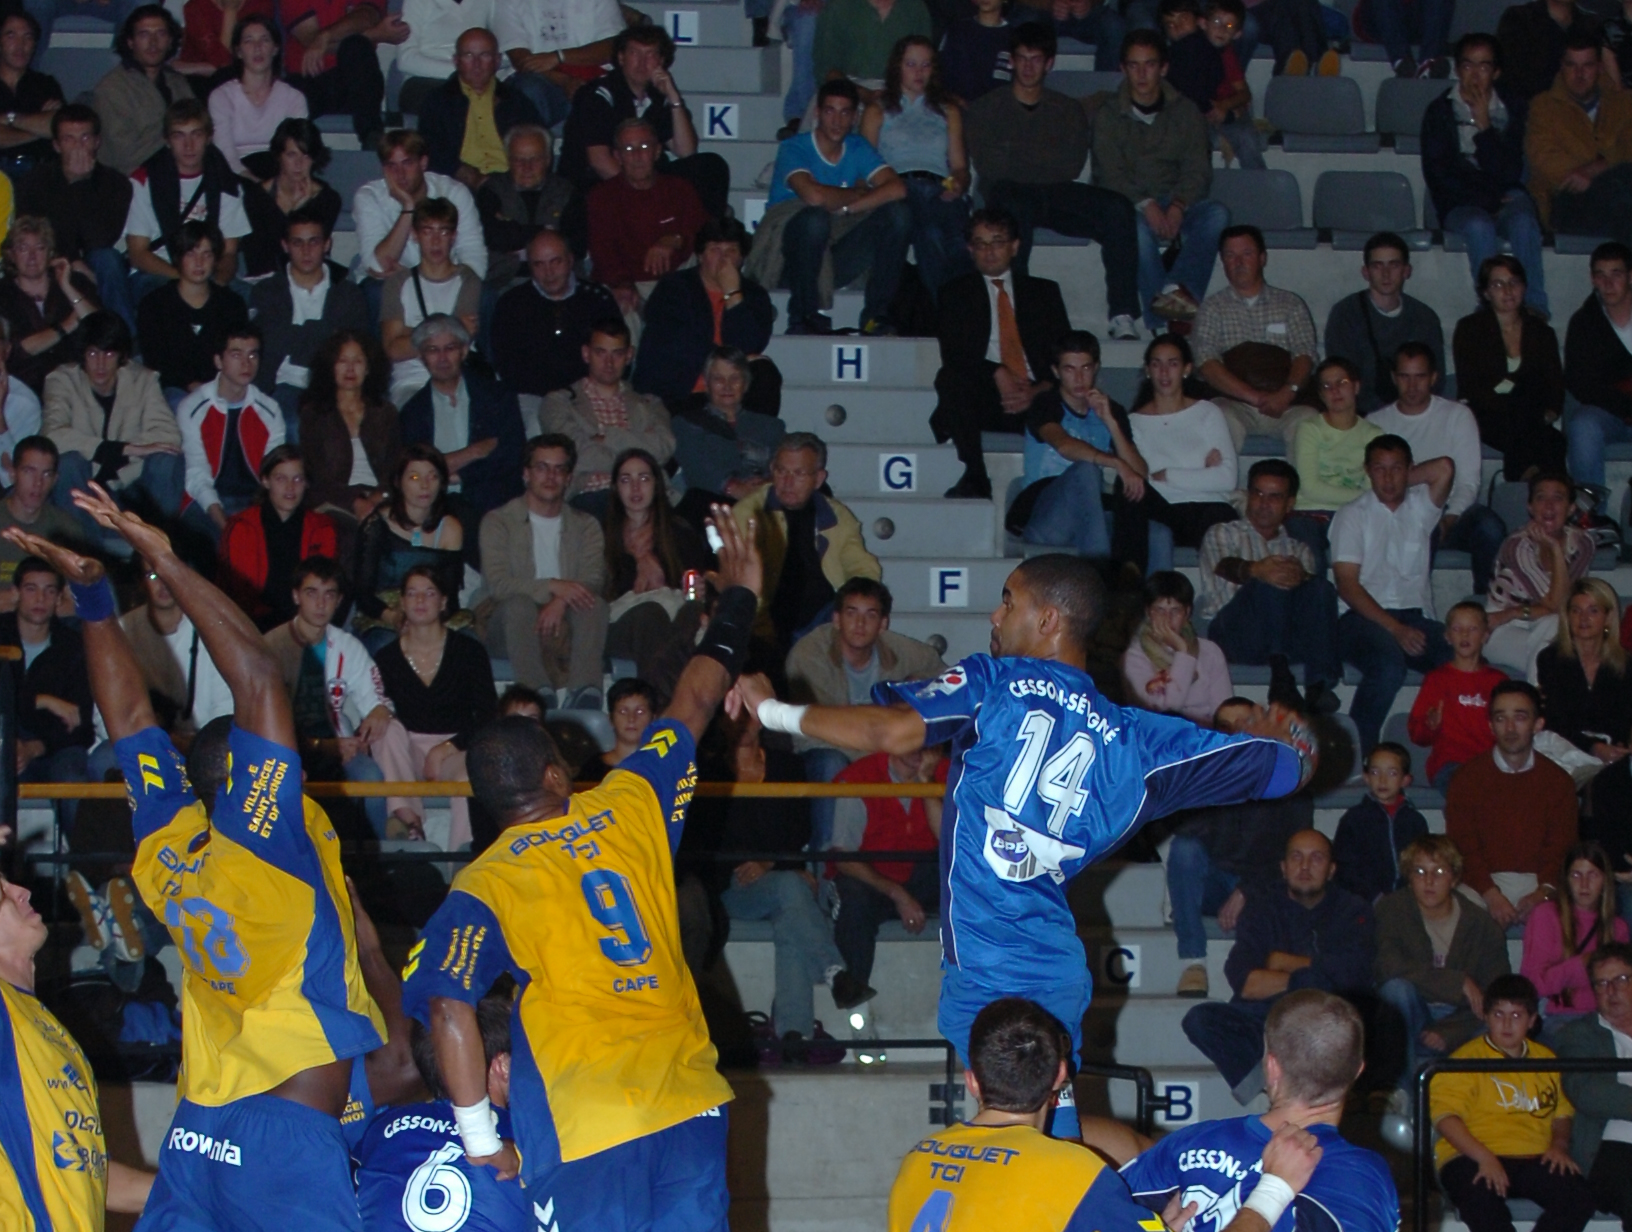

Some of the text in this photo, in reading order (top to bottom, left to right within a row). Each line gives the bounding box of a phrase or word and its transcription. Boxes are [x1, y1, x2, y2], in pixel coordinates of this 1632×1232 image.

[673, 13, 692, 42] L
[709, 106, 733, 136] K
[837, 348, 861, 379] H
[884, 456, 912, 490] G
[939, 571, 962, 604] F
[1003, 709, 1096, 839] 14
[248, 796, 270, 833] SAINT
[260, 821, 273, 839] ET
[580, 867, 654, 967] 9
[1105, 947, 1135, 985] C
[612, 974, 660, 993] CAPE
[1165, 1085, 1193, 1121] B
[930, 1161, 966, 1184] TCI
